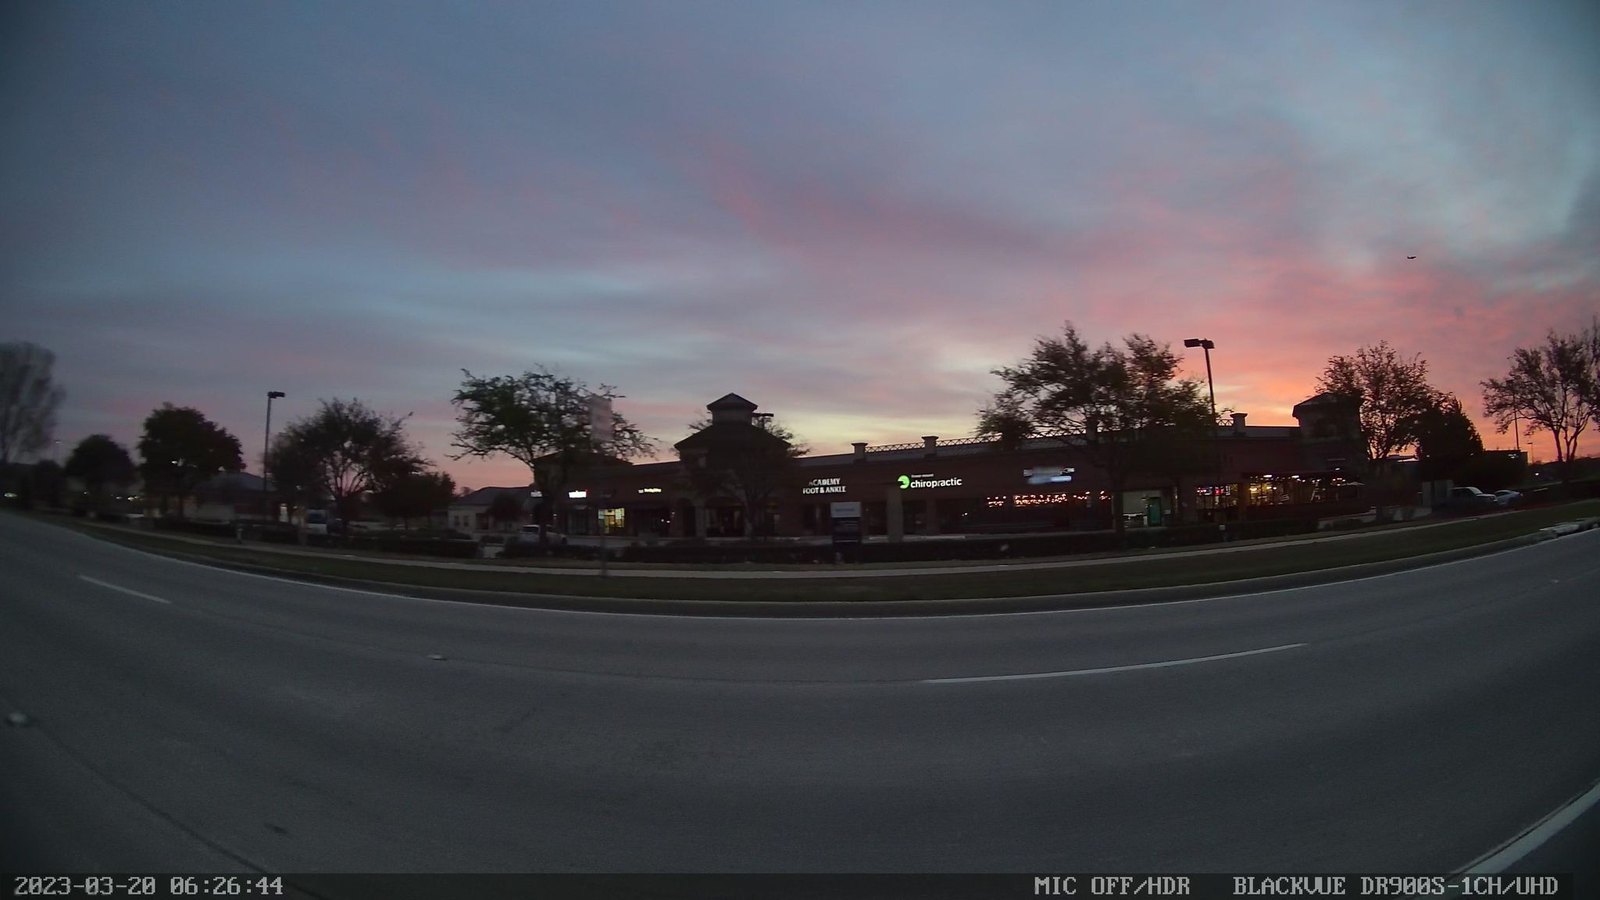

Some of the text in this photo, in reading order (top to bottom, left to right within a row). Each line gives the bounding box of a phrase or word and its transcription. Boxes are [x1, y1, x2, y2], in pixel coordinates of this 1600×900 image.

[910, 477, 963, 489] chiropractic
[802, 487, 819, 495] FOOT
[825, 485, 847, 493] ANKLE
